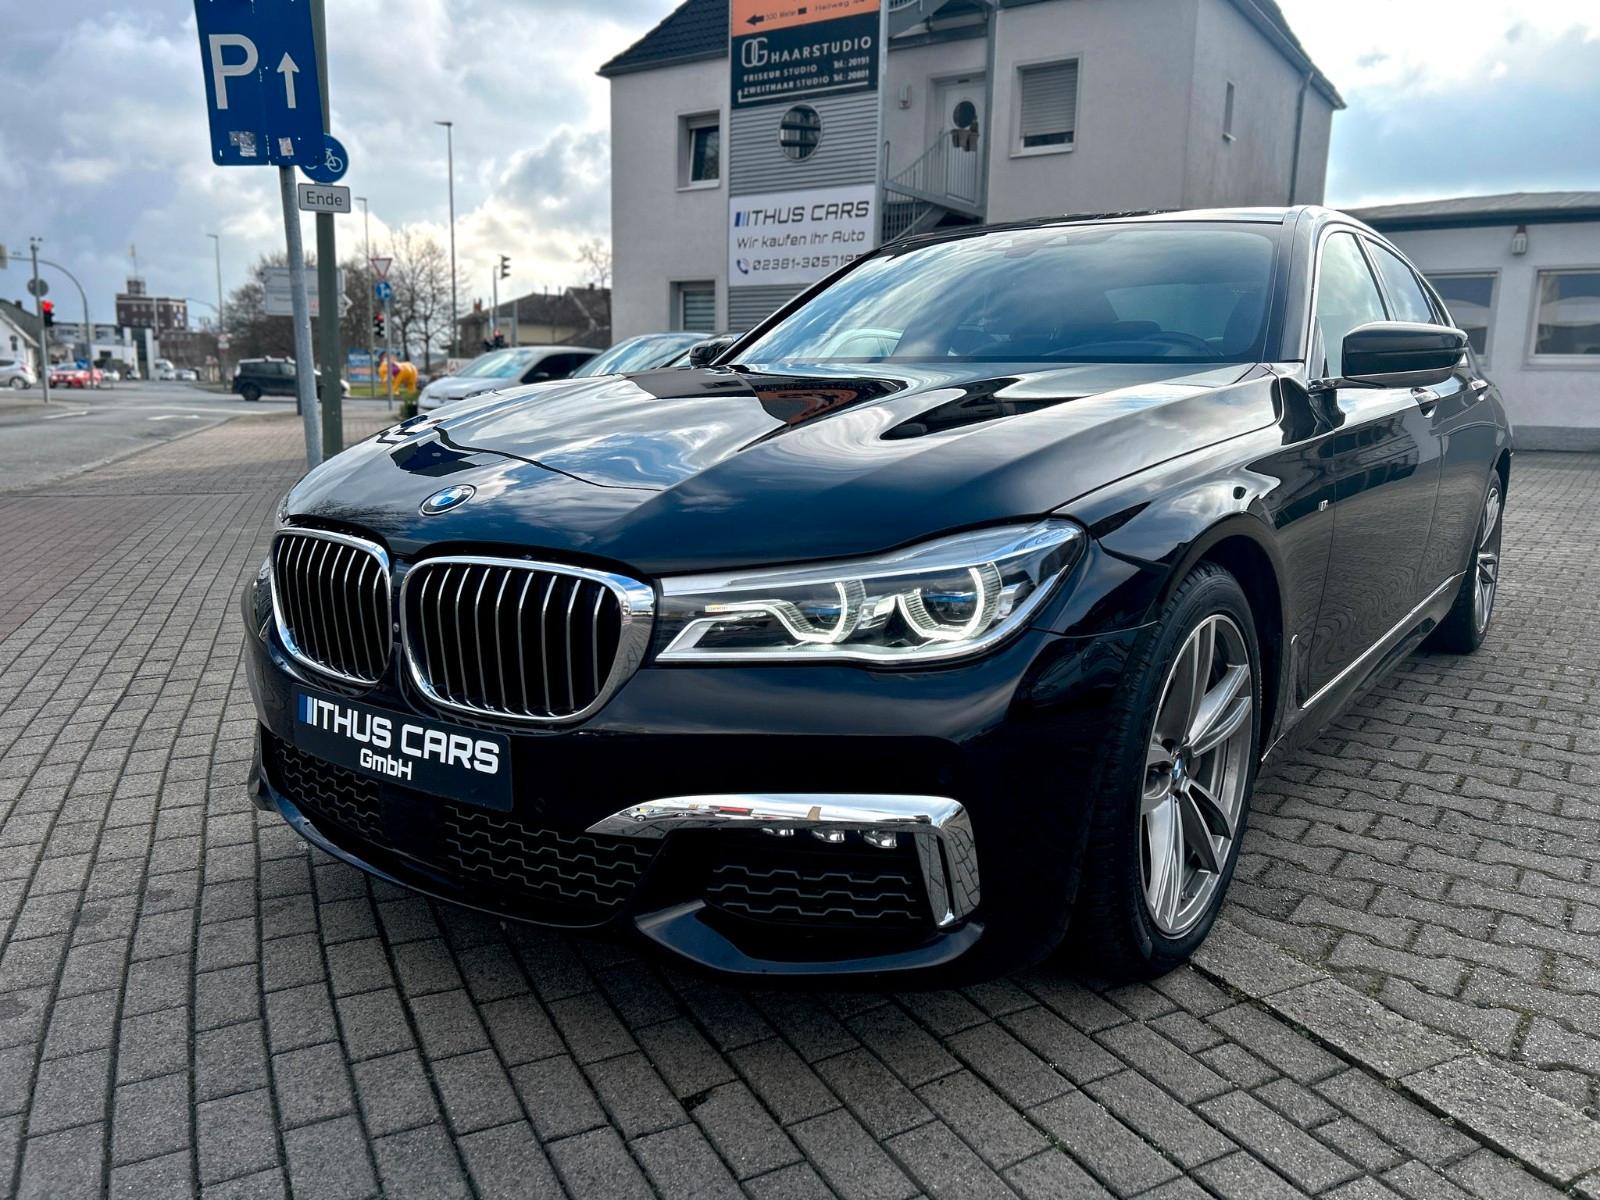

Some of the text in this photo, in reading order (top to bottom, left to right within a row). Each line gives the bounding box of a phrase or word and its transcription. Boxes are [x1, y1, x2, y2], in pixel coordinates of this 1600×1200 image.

[770, 36, 872, 63] HAARSTUDIO
[208, 34, 259, 110] P
[743, 64, 817, 83] FRISEUR STUDIO
[743, 75, 830, 95] ZWEITHAAR STUDIO
[306, 191, 343, 207] Ende
[810, 200, 870, 222] CARS
[736, 237, 757, 249] Wir
[761, 233, 807, 248] kaufen
[832, 230, 865, 243] Auto
[401, 723, 500, 775] CARS
[359, 749, 413, 781] GmbH
